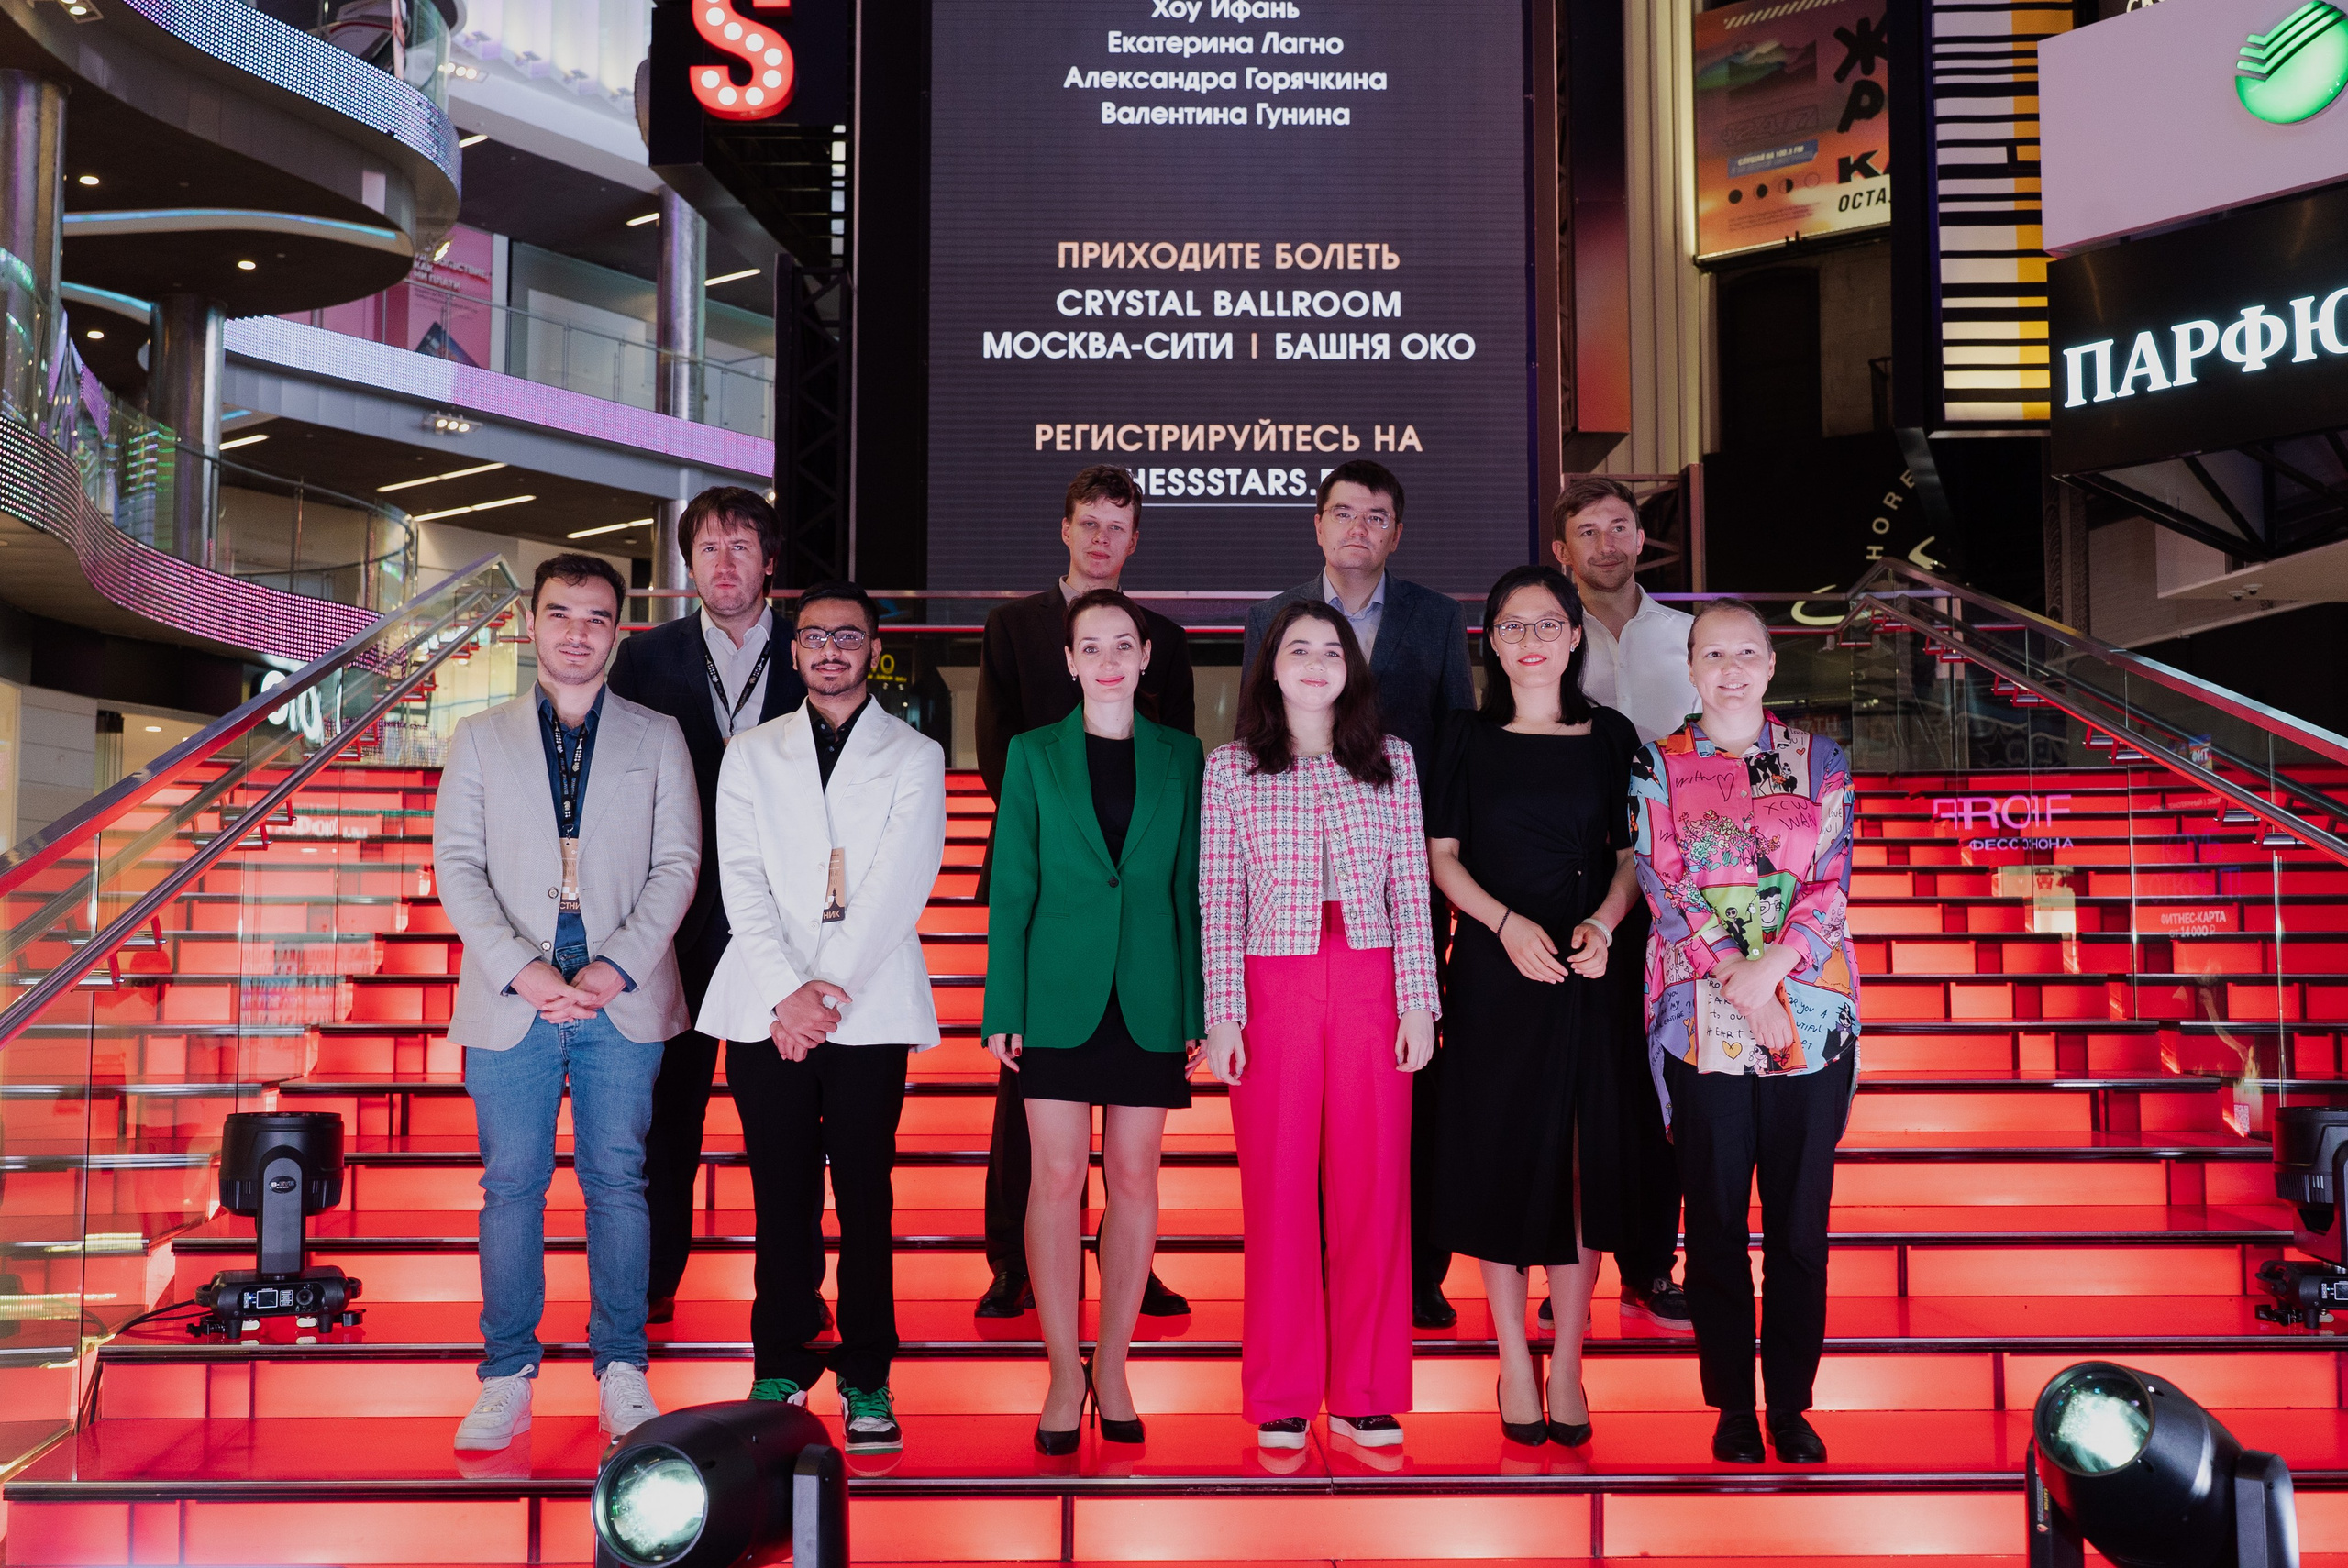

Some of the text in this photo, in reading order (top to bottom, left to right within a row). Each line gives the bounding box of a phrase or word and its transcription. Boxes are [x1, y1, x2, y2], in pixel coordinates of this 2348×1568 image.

[1151, 0, 1300, 23] Хоу Ифань
[690, 0, 794, 116] S
[1108, 30, 1345, 58] Екатерина Лагно
[1064, 66, 1388, 94] Александра Горячкина
[1101, 102, 1351, 129] Валентина Гунина
[1838, 149, 1889, 183] К
[1838, 187, 1891, 212] ОСТА
[1058, 242, 1401, 272] ПРИХОДИТЕ БОЛЕТЬ
[1057, 289, 1401, 318] CRYSTAL BALLROOM
[982, 331, 1234, 360] МОСКВА-СИТИ
[1275, 333, 1390, 360] БАШНЯ
[1401, 332, 1476, 361] ОКО
[2064, 286, 2348, 408] ПАРФЮ
[1035, 419, 1423, 453] РЕГИСТРИРУЙТЕСЬ НА
